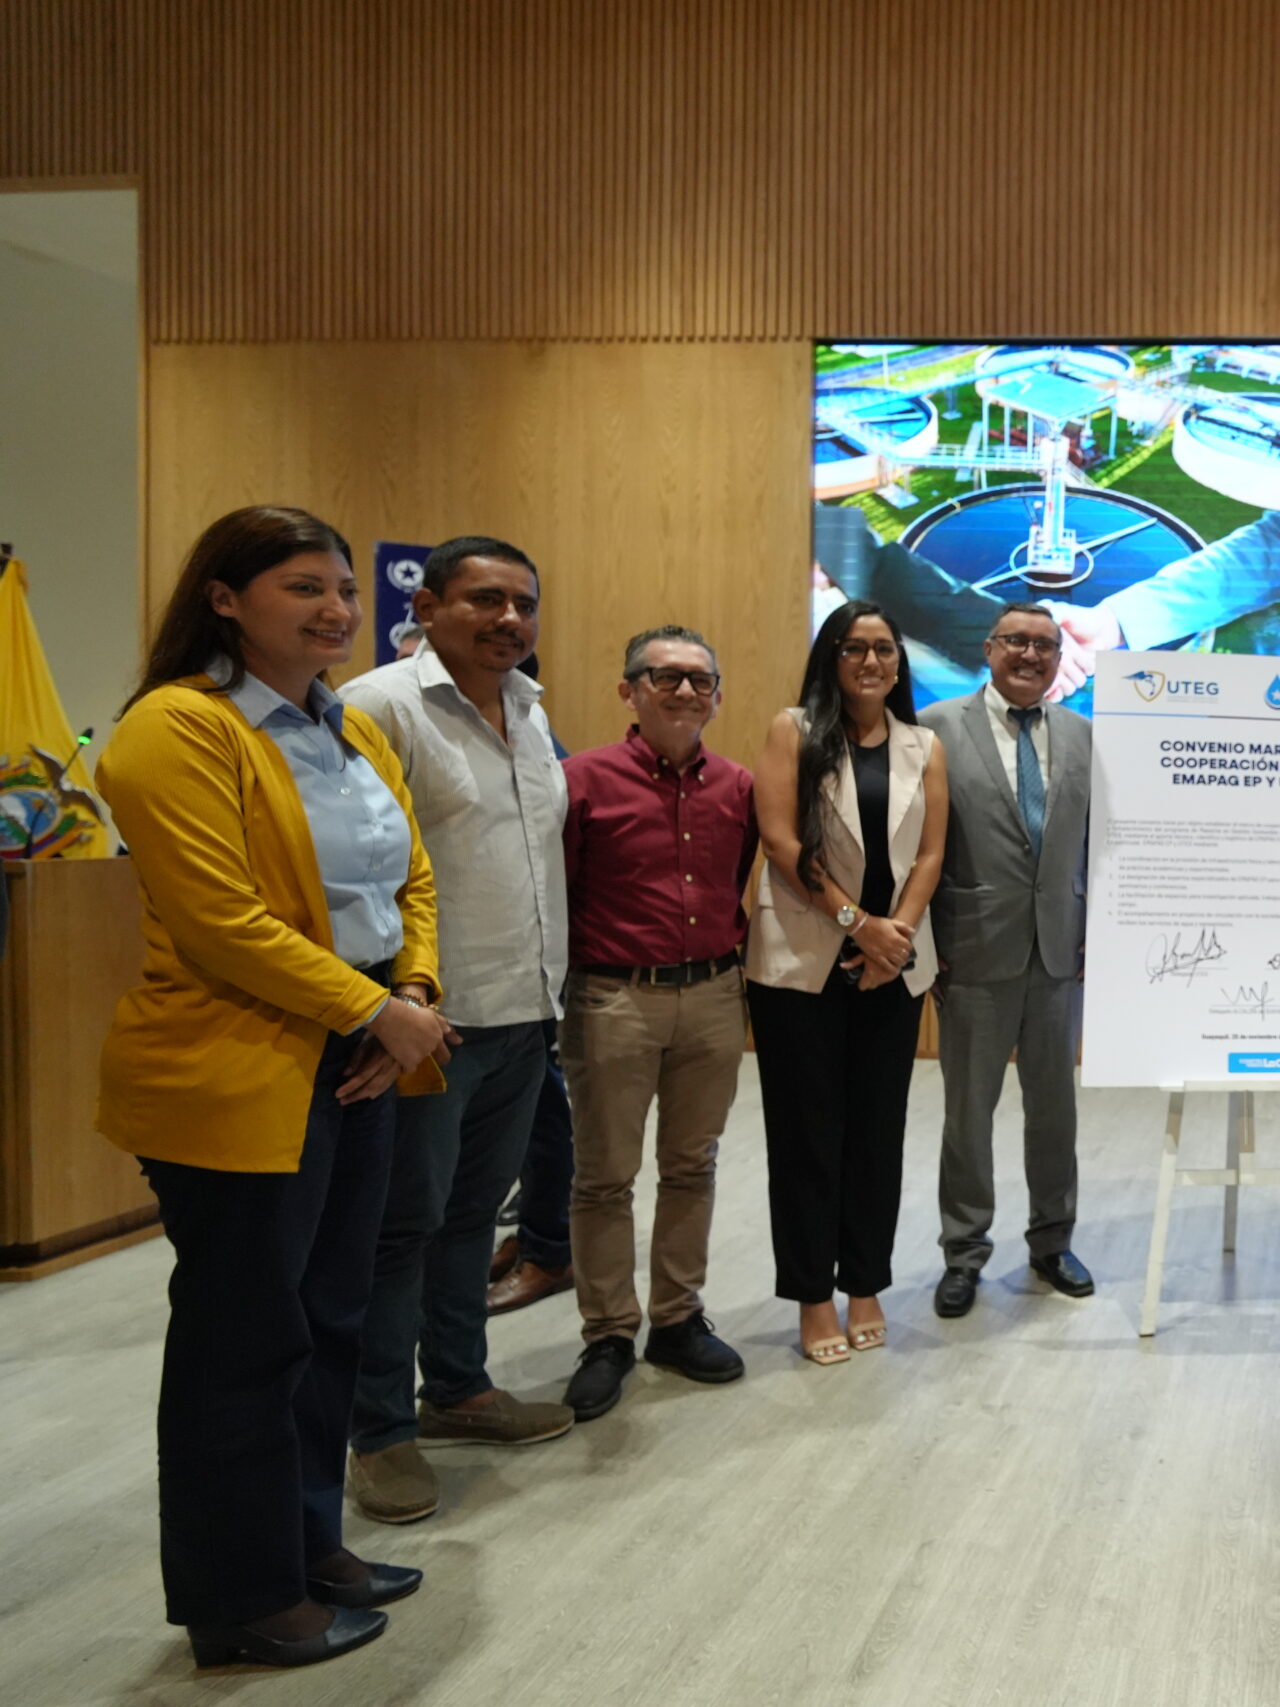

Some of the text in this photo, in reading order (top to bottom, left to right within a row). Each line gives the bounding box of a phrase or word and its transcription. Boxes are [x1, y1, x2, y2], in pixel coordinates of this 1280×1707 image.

[1167, 680, 1220, 696] UTEG
[1160, 740, 1245, 755] CONVENIO
[1160, 756, 1279, 772] COOPERACIÓN
[1172, 773, 1239, 787] EMAPAG
[1244, 776, 1262, 787] EP
[1266, 777, 1276, 788] Y
